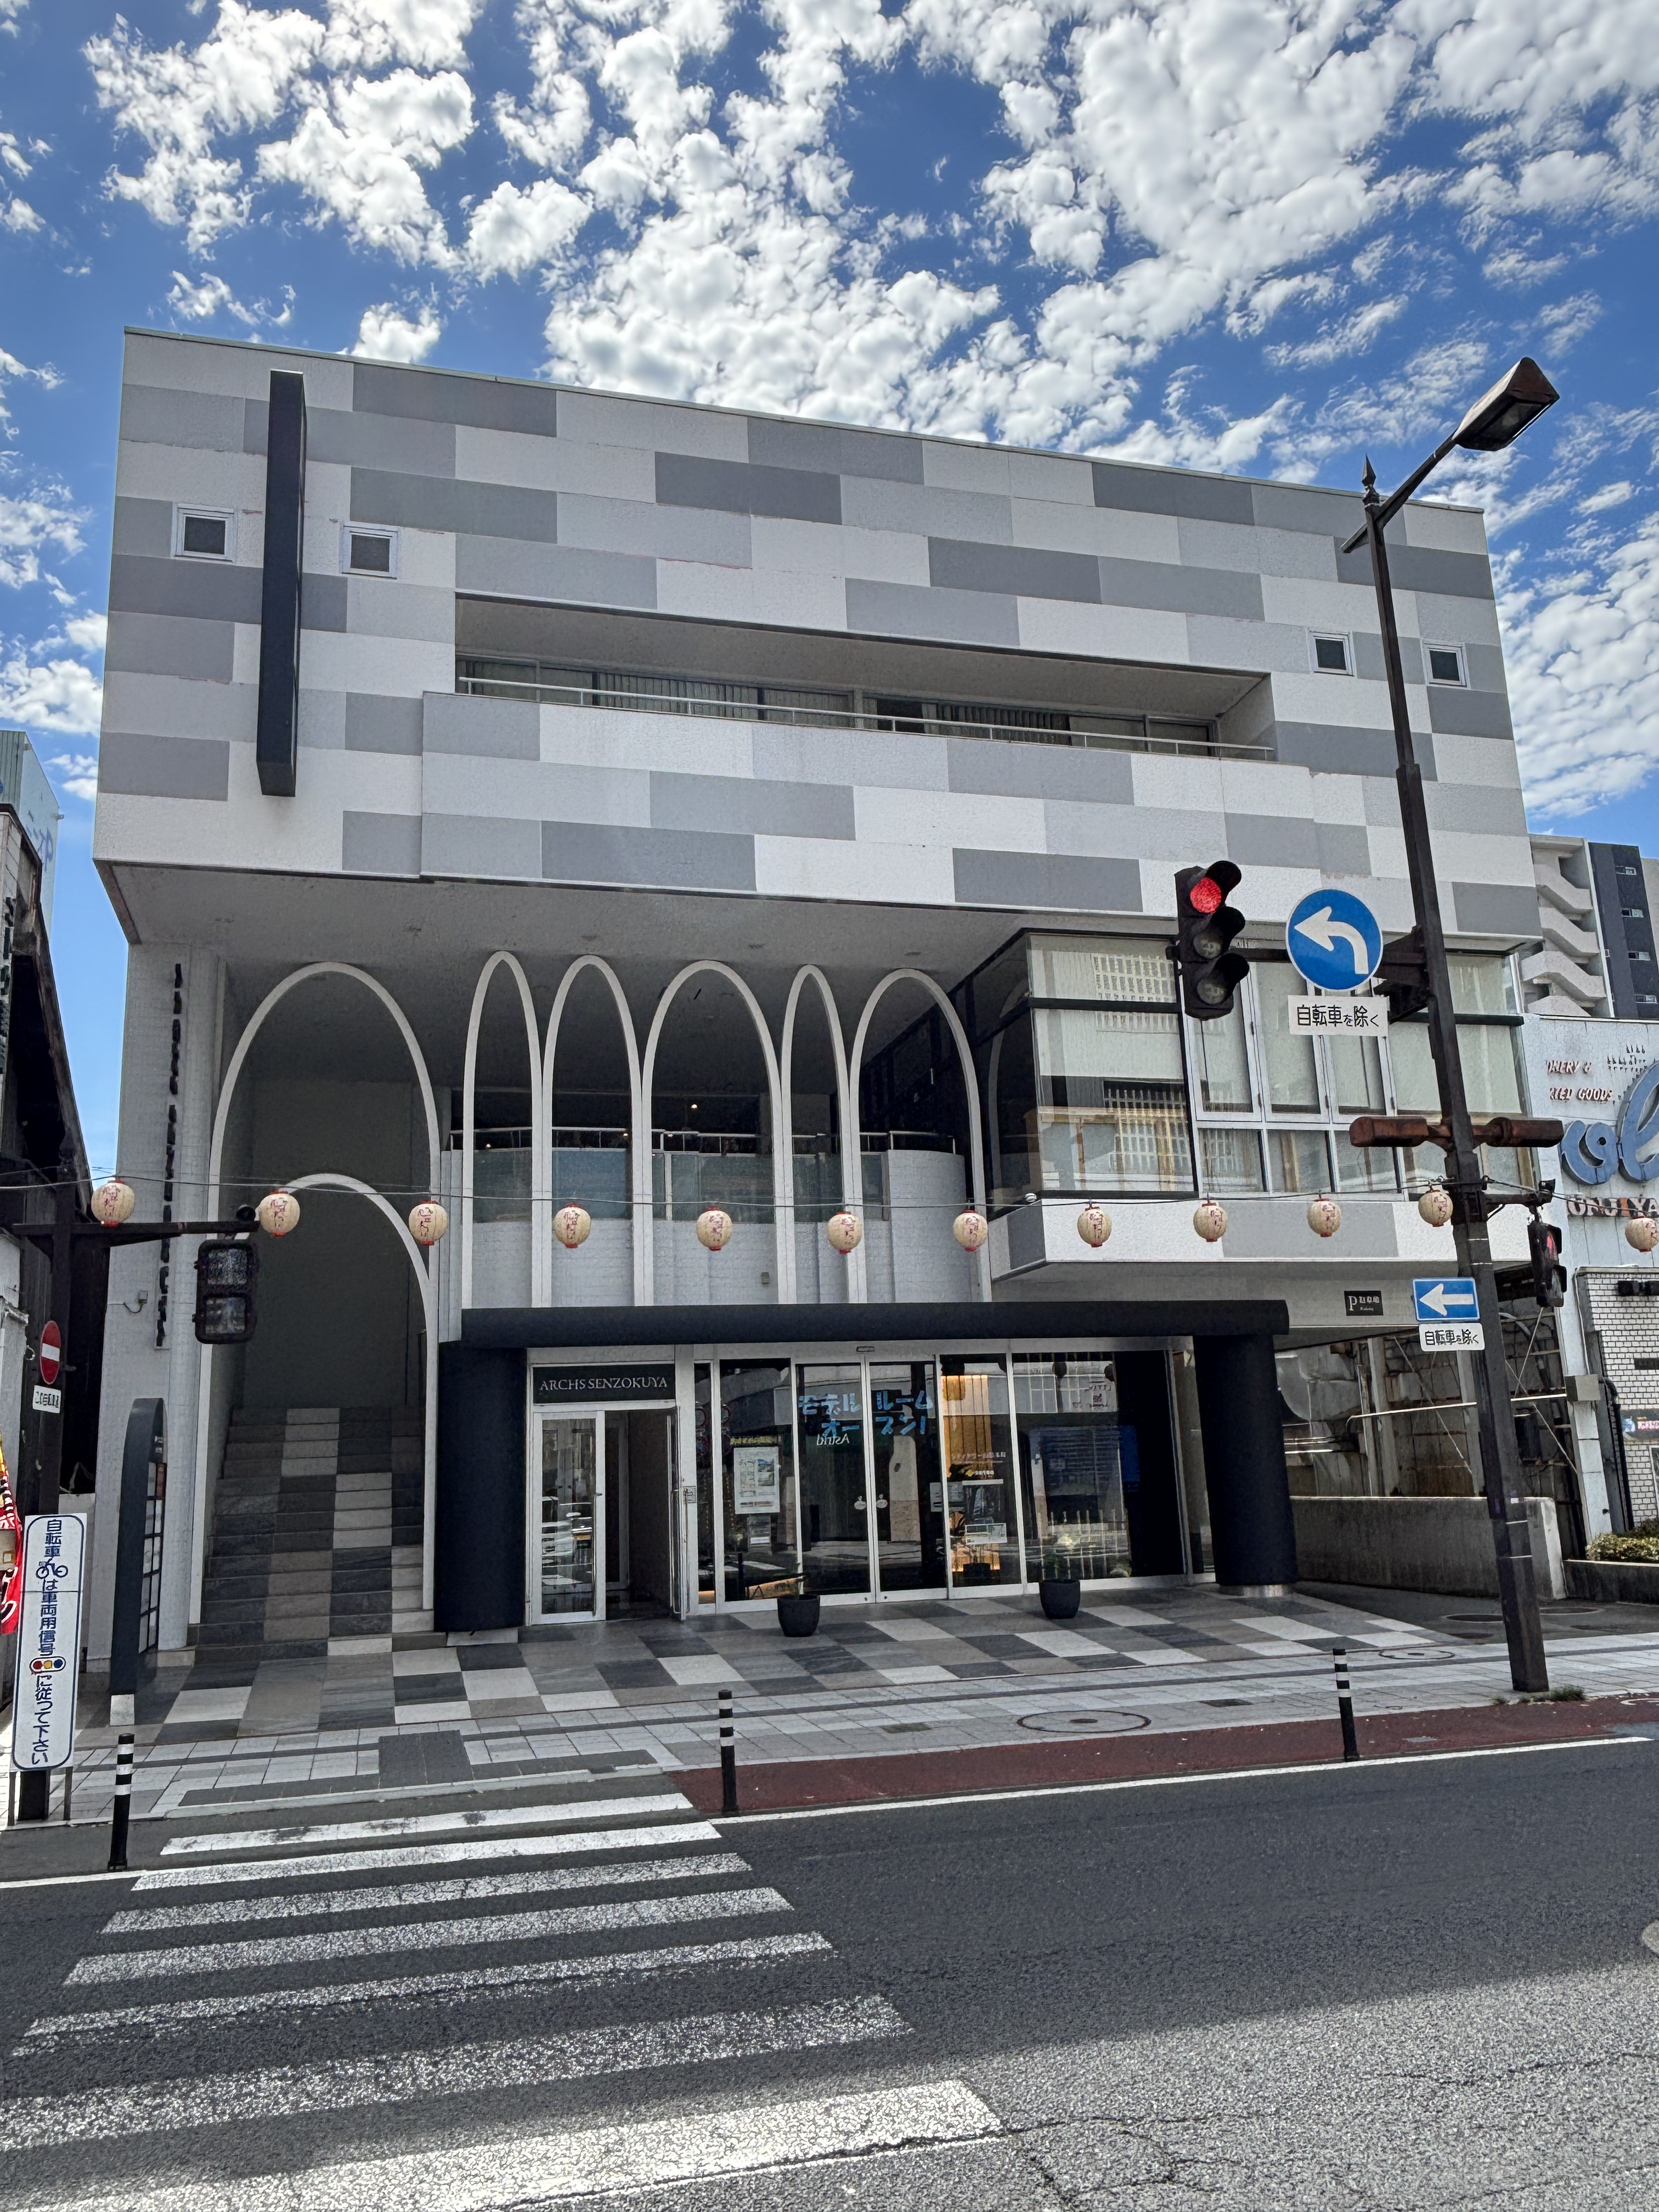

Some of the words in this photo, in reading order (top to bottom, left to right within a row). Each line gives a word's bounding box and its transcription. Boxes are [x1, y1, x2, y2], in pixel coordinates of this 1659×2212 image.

[1297, 1004, 1379, 1027] 自転車を除く
[1425, 1329, 1479, 1346] 自転車を除く
[540, 1379, 586, 1391] ARCHS
[588, 1376, 668, 1389] SENZOKUYA
